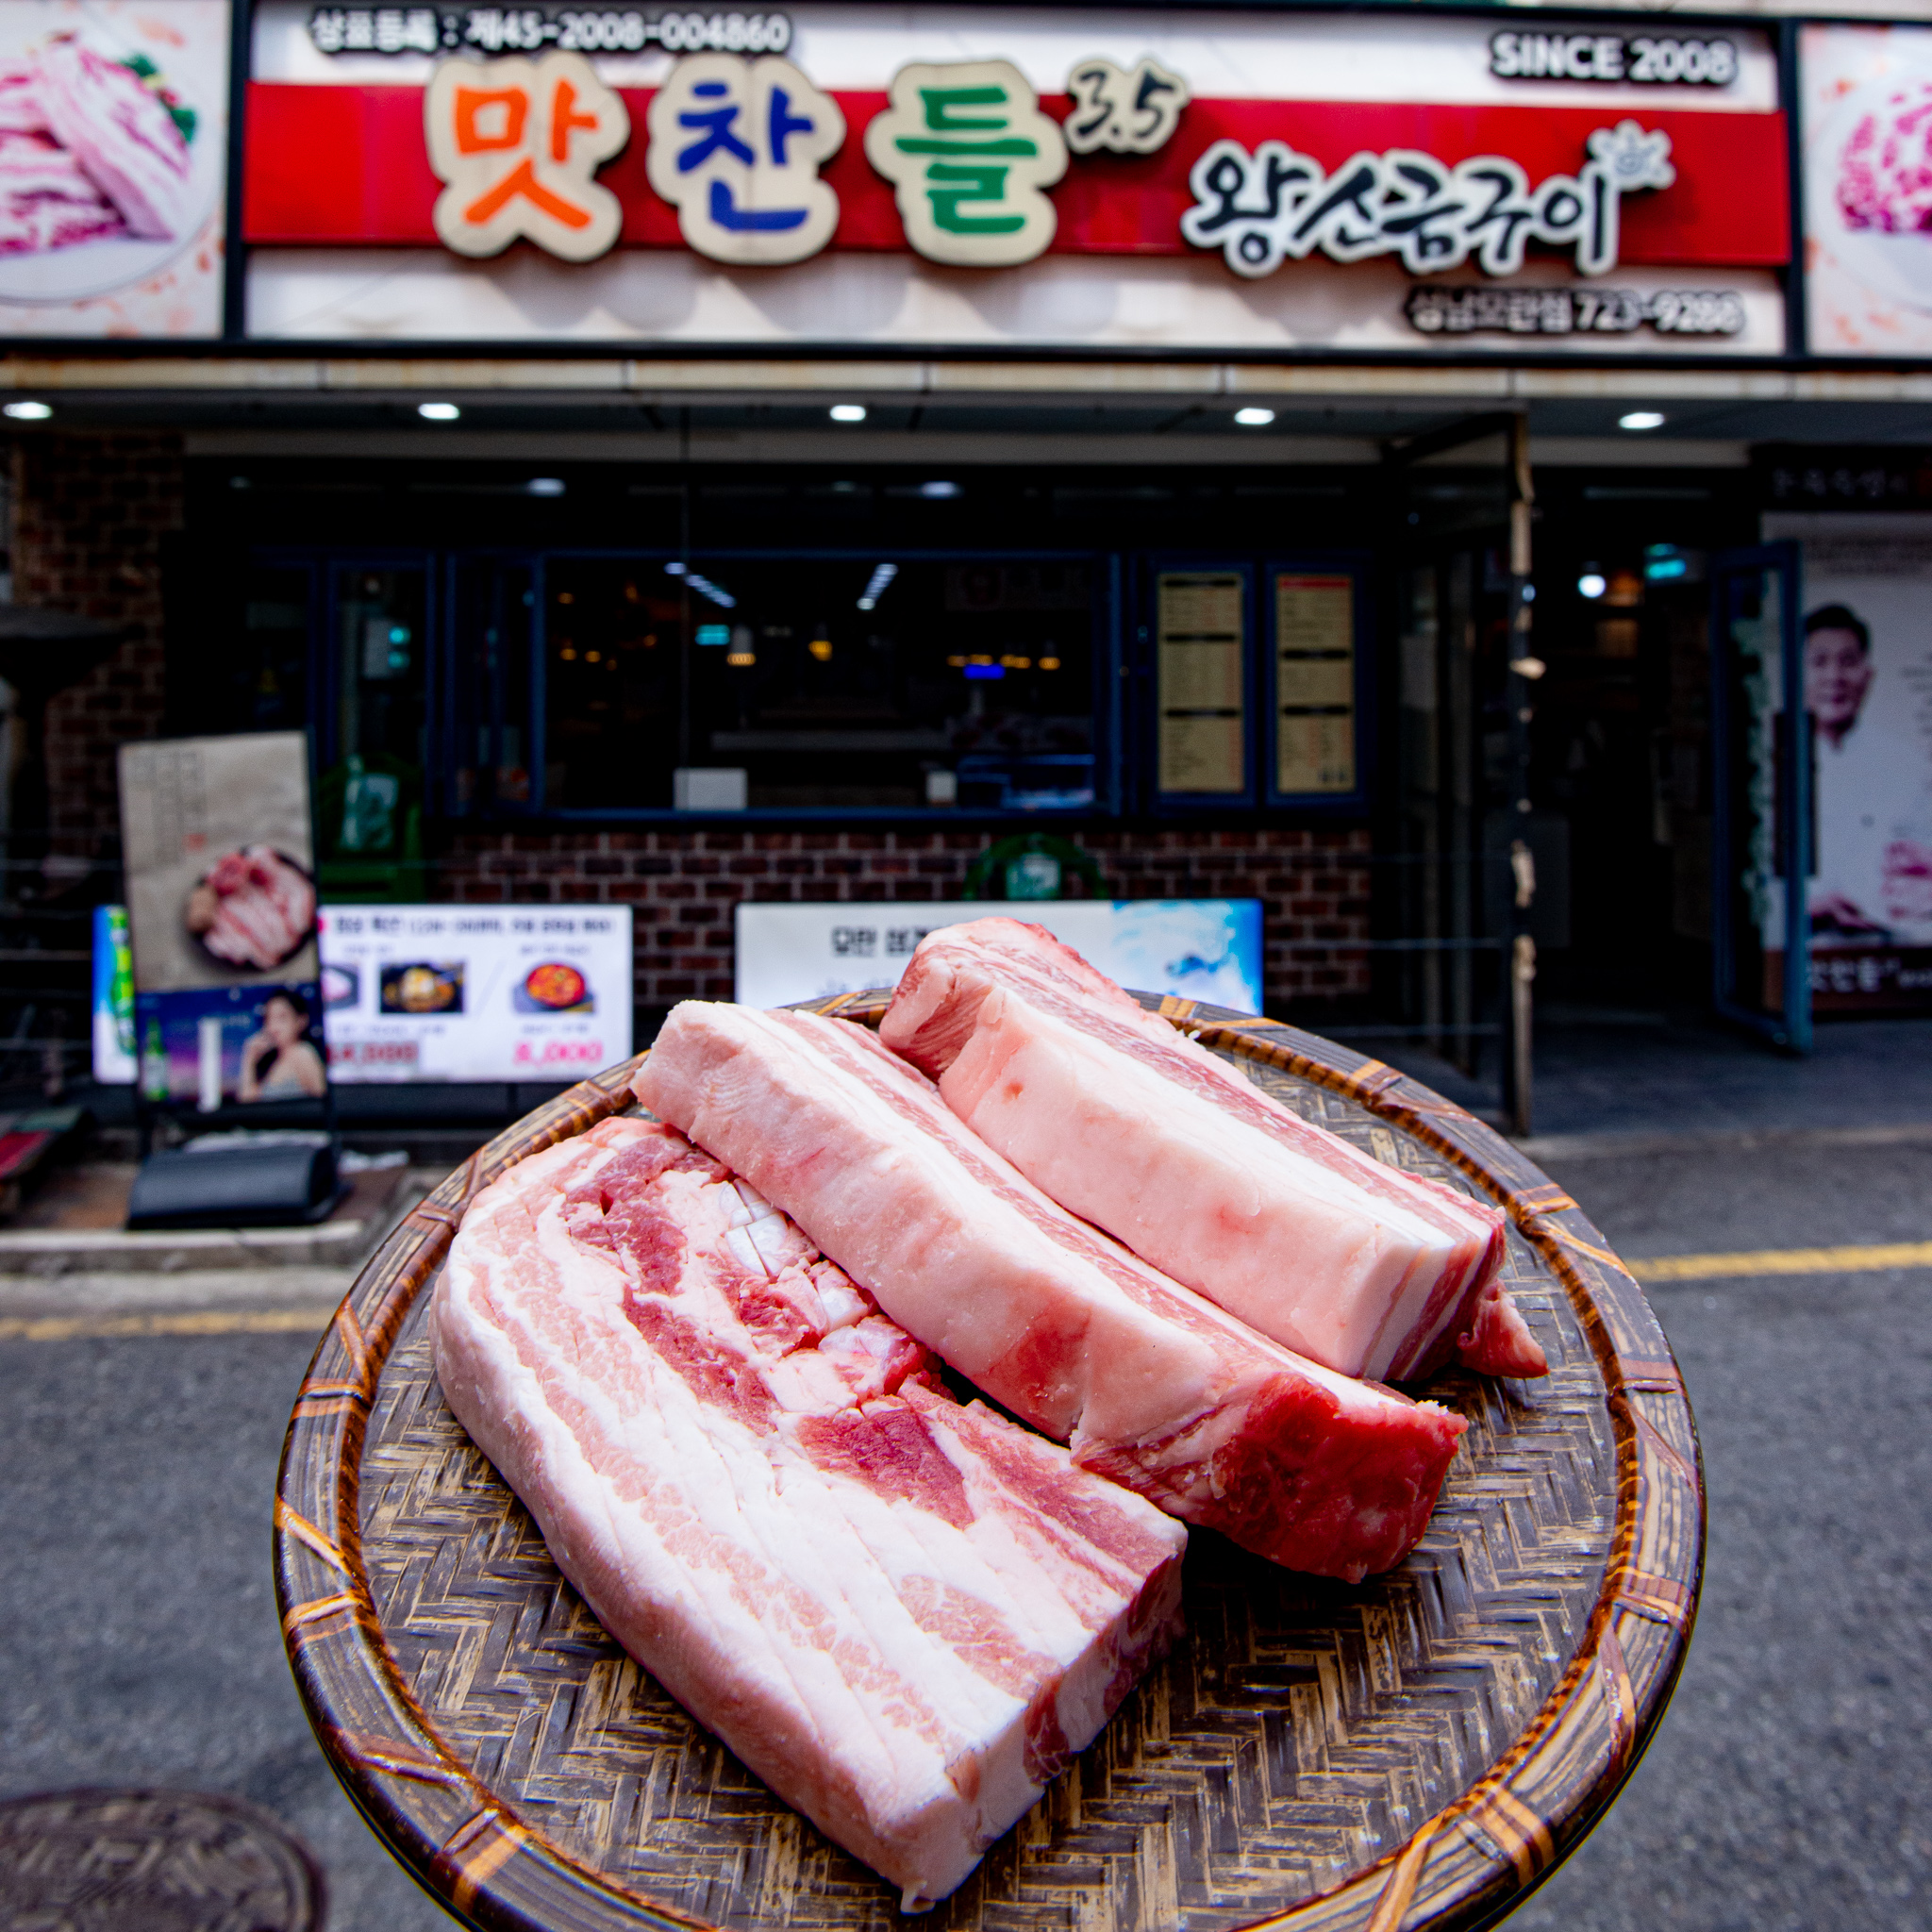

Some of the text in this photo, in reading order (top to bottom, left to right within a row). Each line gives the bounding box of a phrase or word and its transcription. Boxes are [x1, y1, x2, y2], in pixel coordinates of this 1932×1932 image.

[1492, 32, 1737, 84] SINCE 2008
[451, 67, 1607, 265] 맛찬들 3.5 왕소금구이
